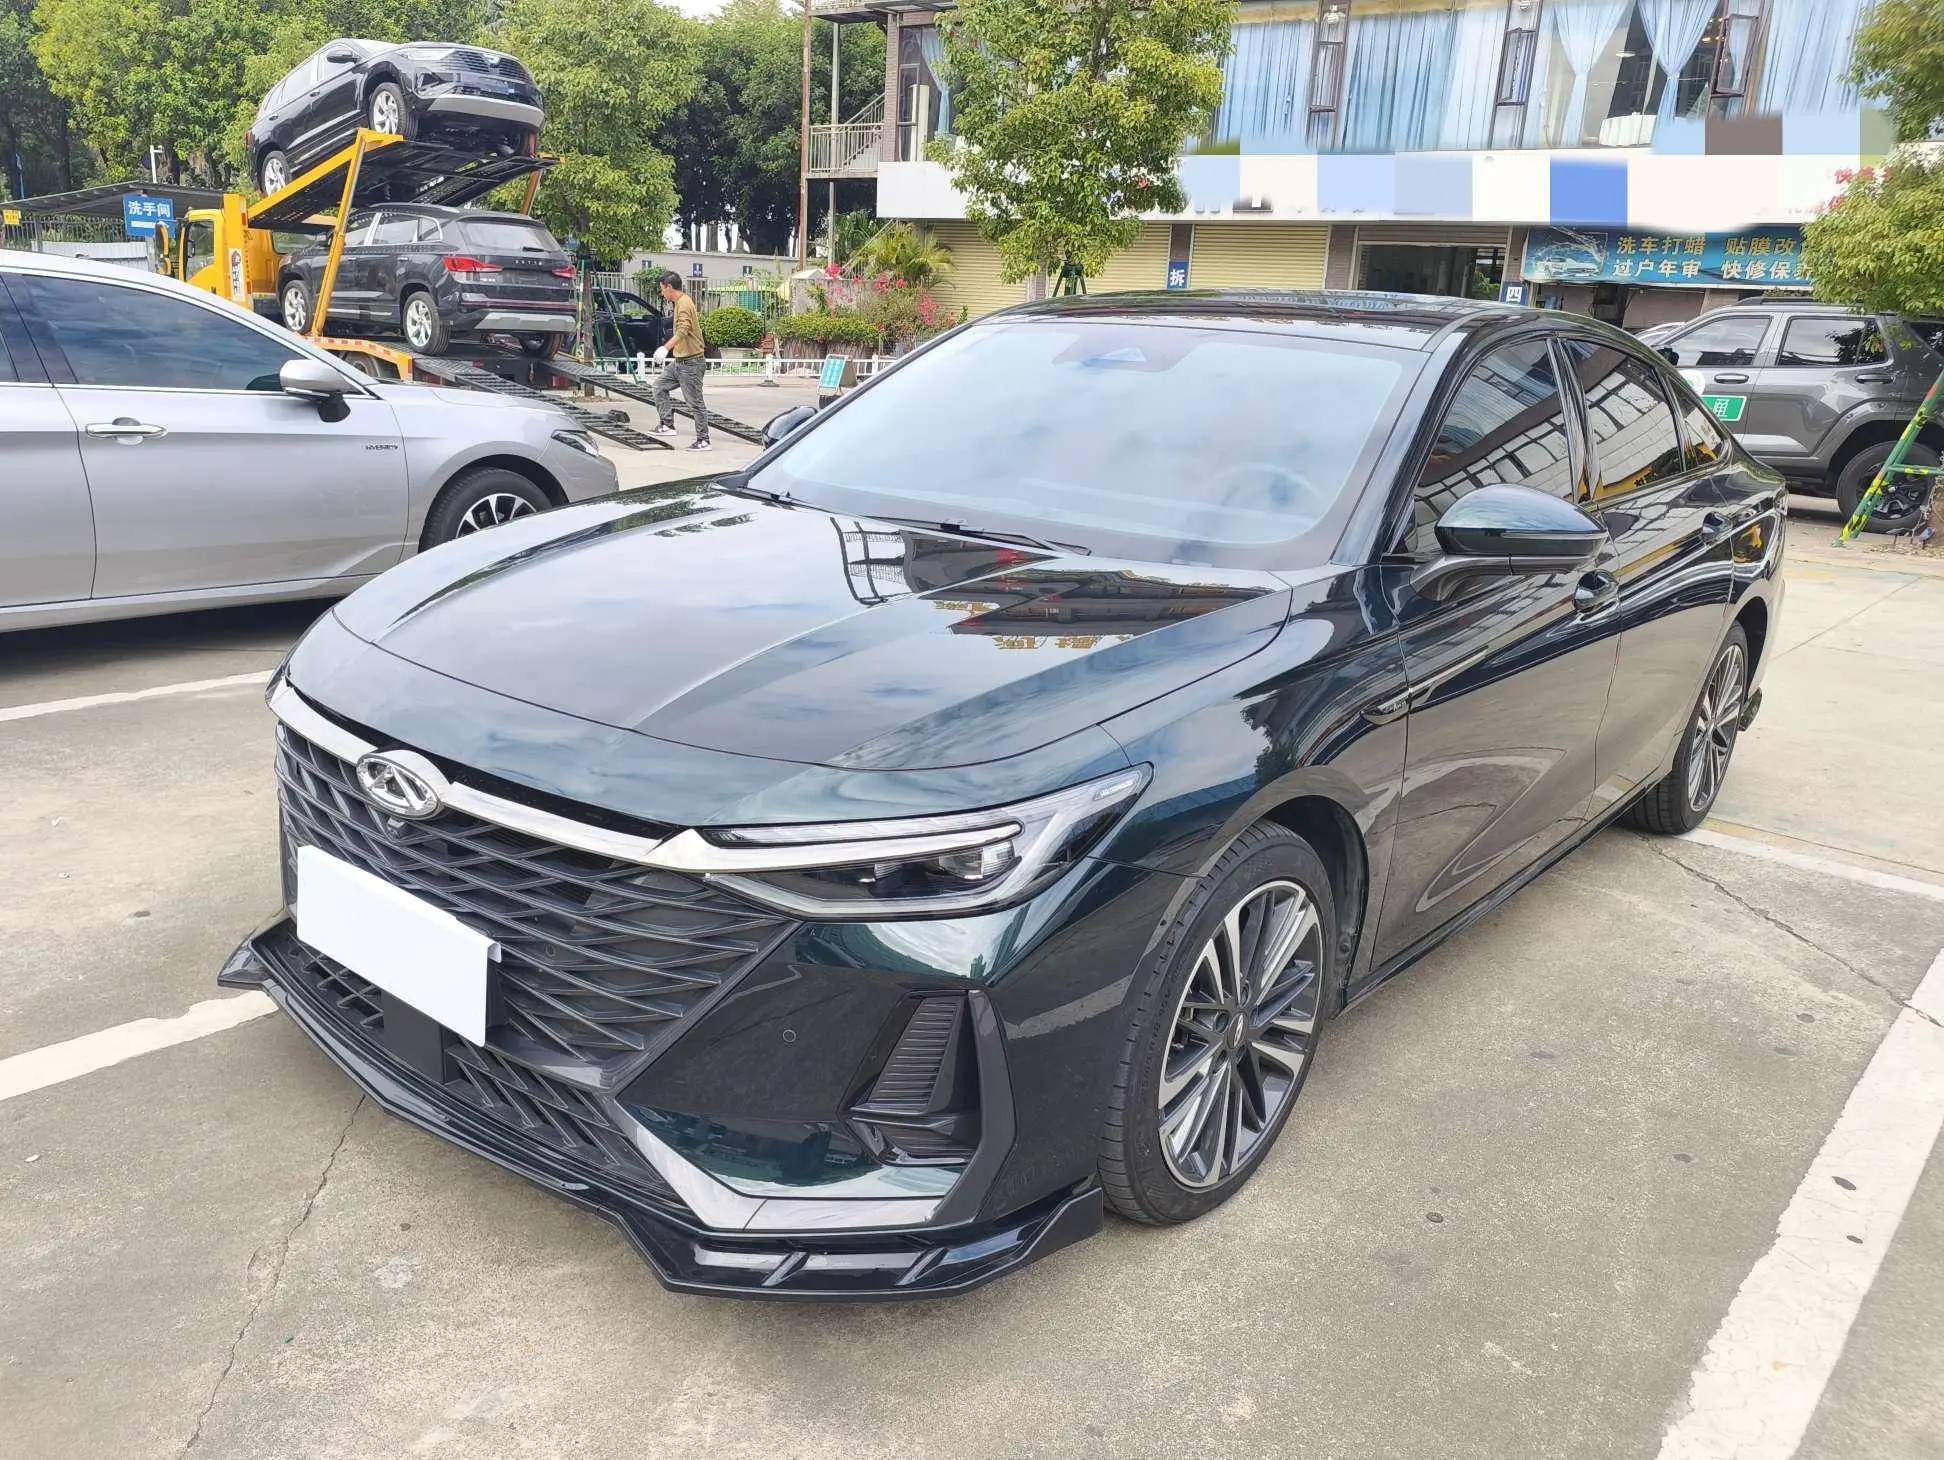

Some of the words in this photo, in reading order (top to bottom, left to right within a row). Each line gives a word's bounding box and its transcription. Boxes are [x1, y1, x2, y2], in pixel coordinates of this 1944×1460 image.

[128, 200, 171, 217] 洗手间
[1617, 236, 1706, 255] 洗车打蜡
[1726, 237, 1806, 256] 贴膜改
[1170, 269, 1185, 287] 拆
[1612, 260, 1702, 278] 过户年审
